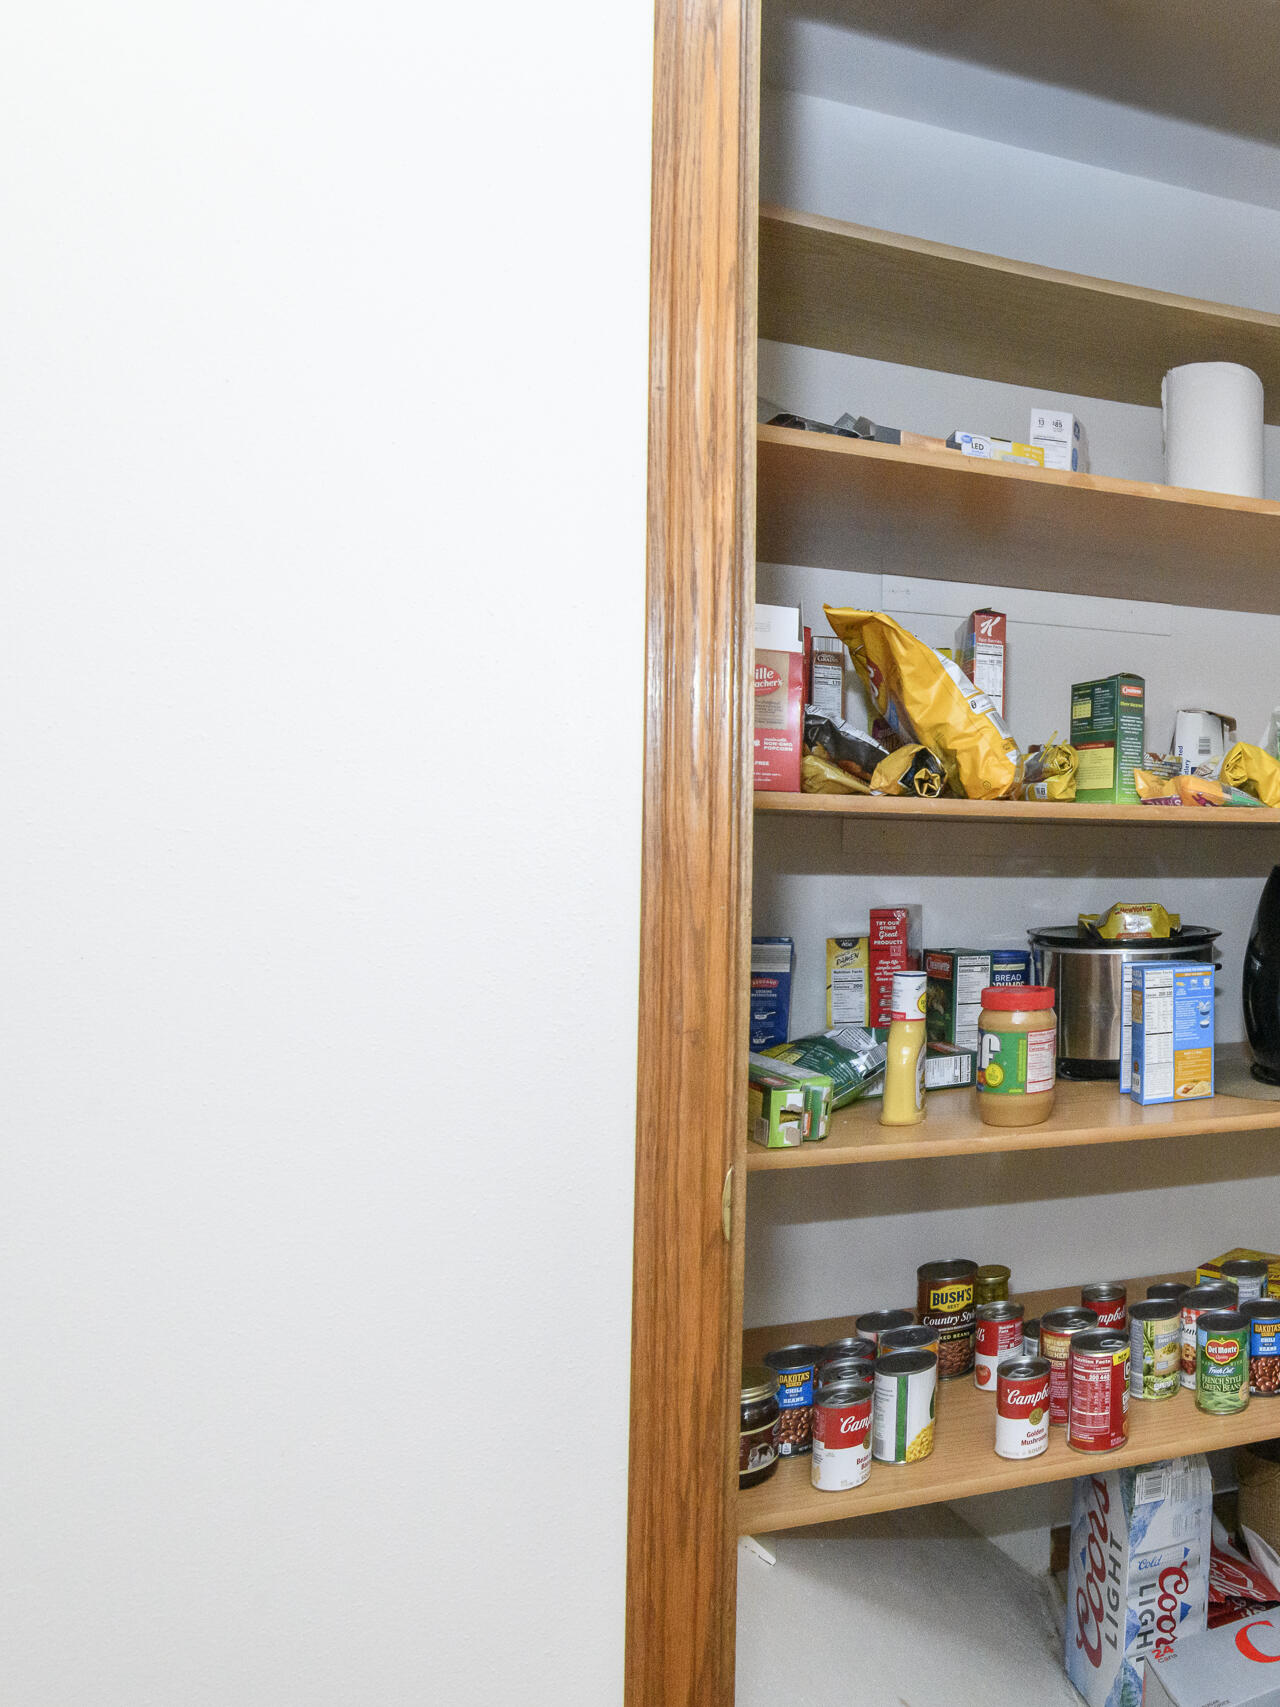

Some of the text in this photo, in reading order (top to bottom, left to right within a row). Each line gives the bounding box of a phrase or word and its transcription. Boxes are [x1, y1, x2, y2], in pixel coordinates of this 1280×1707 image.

[971, 442, 984, 451] LED
[878, 930, 898, 940] Great
[995, 974, 1022, 982] BREAD
[932, 1287, 972, 1307] BUSH'S
[923, 1314, 960, 1327] Country
[1217, 1346, 1238, 1354] Monte
[840, 1413, 872, 1434] Camp
[1026, 1427, 1045, 1438] Golden
[1138, 1554, 1162, 1571] Cold
[1076, 1477, 1110, 1669] Coors
[1105, 1533, 1123, 1651] LIGHT
[1156, 1560, 1189, 1650] Coor
[1152, 1645, 1174, 1660] 24
[1157, 1652, 1178, 1664] Cans
